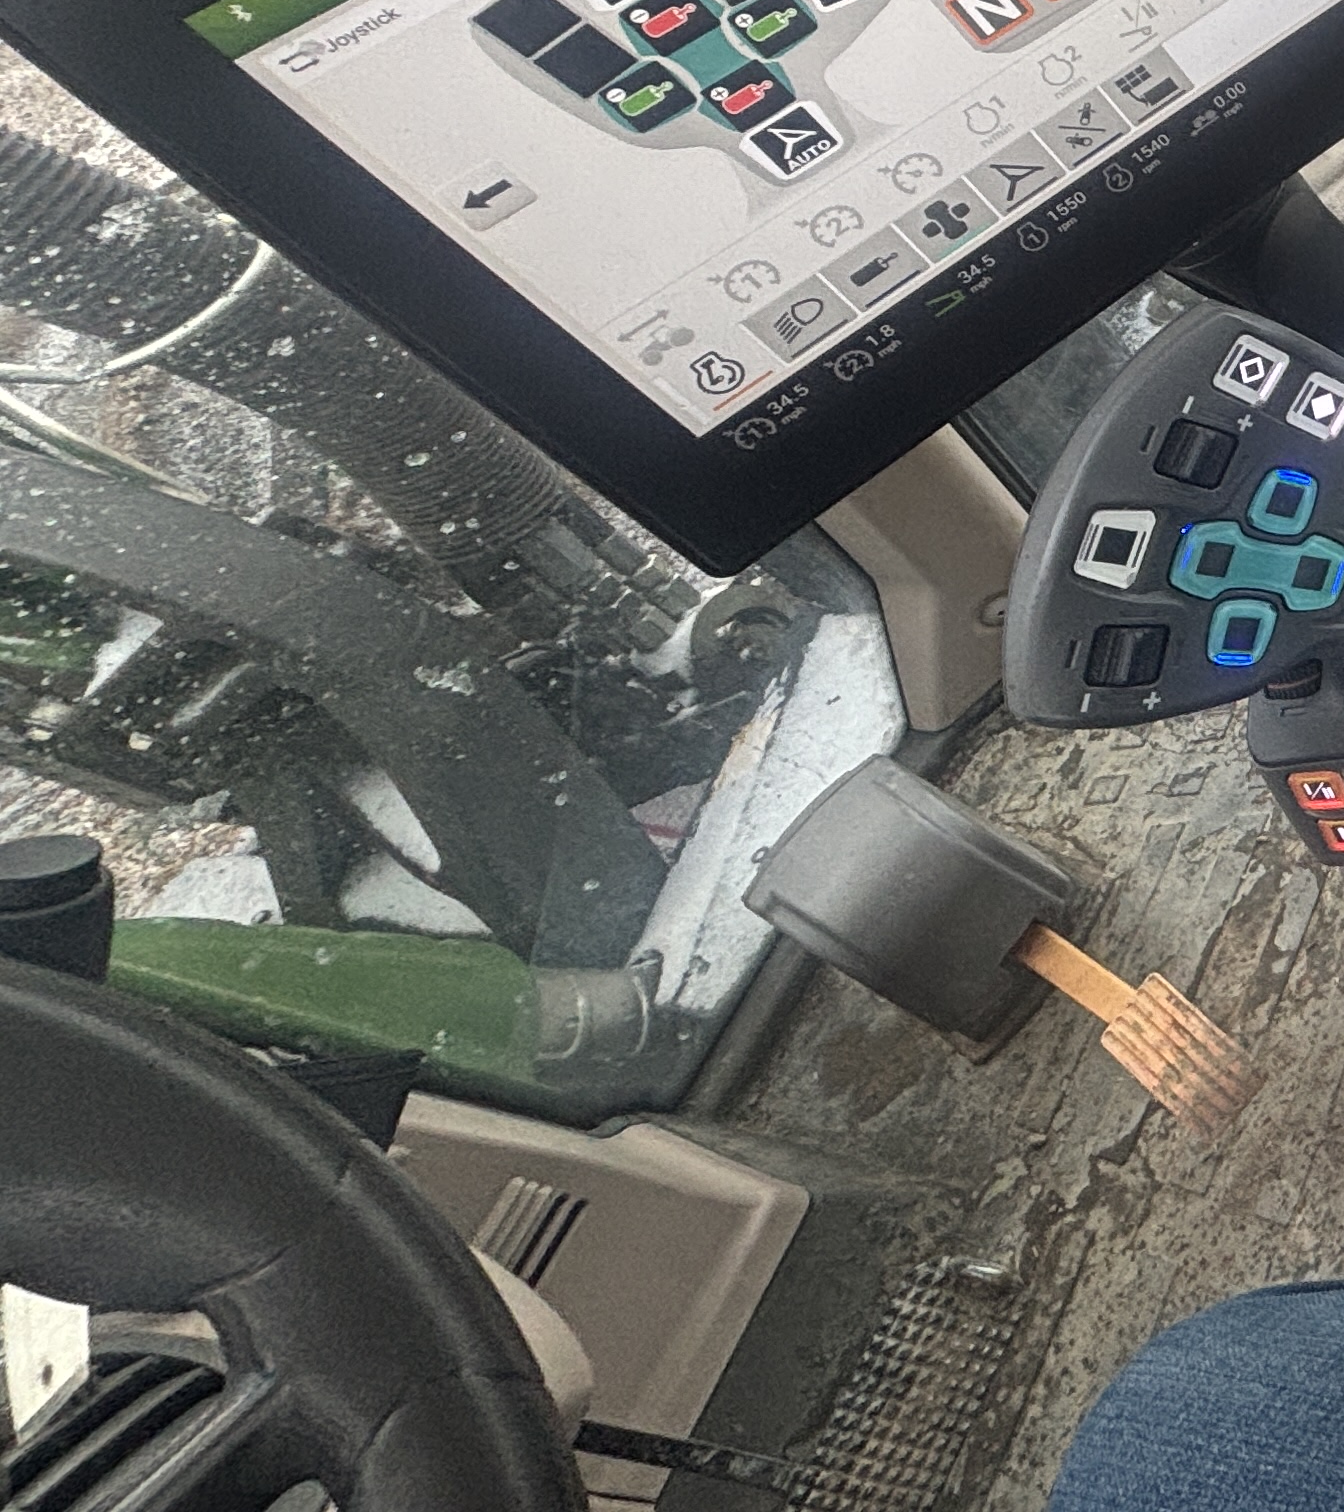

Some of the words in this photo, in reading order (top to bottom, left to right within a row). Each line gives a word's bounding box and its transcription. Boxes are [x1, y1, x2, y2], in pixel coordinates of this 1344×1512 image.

[326, 8, 402, 53] Joystick
[1064, 45, 1082, 62] 2
[988, 94, 1006, 109] 1
[787, 139, 832, 172] AUTO
[1131, 133, 1171, 163] 1540
[1142, 159, 1161, 175] rpm
[1112, 174, 1128, 187] 2
[1046, 191, 1087, 222] 1550
[826, 217, 851, 237] 2
[1057, 216, 1079, 233] rpm
[957, 254, 996, 284] 34.5
[741, 272, 763, 289] 1
[866, 324, 896, 347] 1.8
[878, 339, 902, 358] mph
[766, 383, 809, 415] 34.5
[780, 405, 808, 425] mph
